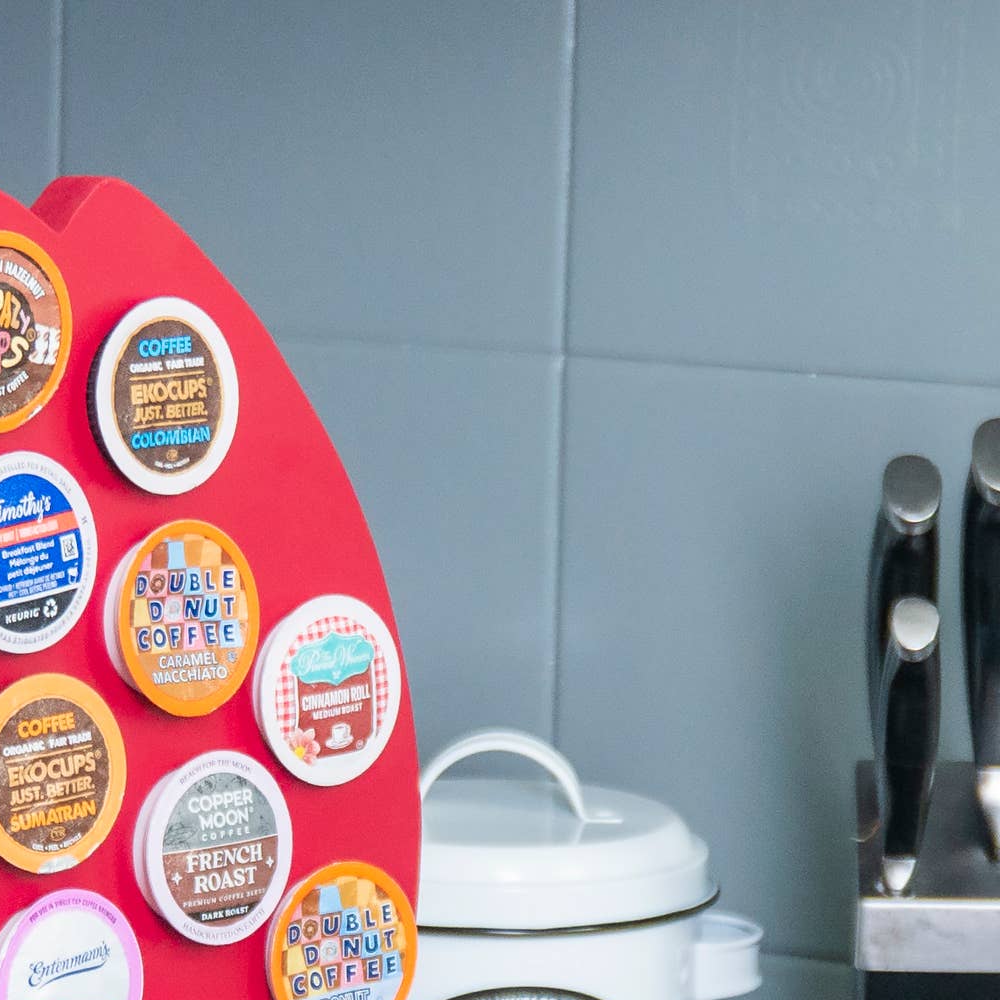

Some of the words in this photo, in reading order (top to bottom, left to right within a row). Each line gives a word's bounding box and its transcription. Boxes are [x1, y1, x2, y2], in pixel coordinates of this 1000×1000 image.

[4, 260, 46, 300] HAZELNUT
[138, 335, 192, 358] COFFEE
[129, 362, 164, 374] ORGANIC
[165, 359, 185, 372] FAIR
[6, 370, 30, 394] COFFEE
[130, 378, 208, 406] EKOCUPS
[133, 406, 163, 423] JUST.
[166, 402, 208, 419] BETTER.
[131, 426, 211, 449] COLOMBIAN
[1, 544, 35, 560] Breakfast
[36, 540, 55, 553] Blend
[39, 553, 49, 561] du
[7, 569, 24, 581] petit
[135, 570, 235, 597] DOUBLE
[5, 608, 40, 624] KEURIG
[137, 624, 236, 650] COFFEE
[158, 652, 219, 669] CARAMEL
[152, 666, 229, 685] MACCHIATO
[302, 690, 350, 711] CINNAMON
[351, 684, 371, 701] ROLL
[312, 708, 341, 721] MEDIUM
[342, 703, 363, 715] ROAST
[17, 712, 75, 738] COFFEE
[3, 740, 45, 757] ORGANIC
[49, 736, 69, 749] FAIR
[69, 731, 93, 744] TRADE
[7, 752, 97, 788] EKOCUPS
[10, 786, 44, 806] JUST.
[46, 776, 95, 798] BETTER.
[188, 788, 254, 814] COPPER
[9, 800, 97, 833] SUMATRAN
[199, 808, 250, 831] MOON
[201, 826, 251, 842] COFFEE
[185, 842, 263, 874] FRENCH
[193, 866, 258, 895] ROAST
[183, 897, 217, 908] PREMIUM
[218, 892, 244, 903] COFFEE
[201, 909, 224, 921] DARK
[225, 905, 249, 918] ROAST
[287, 902, 393, 945] DOUBLE
[28, 941, 111, 988] Entenmann's
[292, 956, 397, 996] COFFEE
